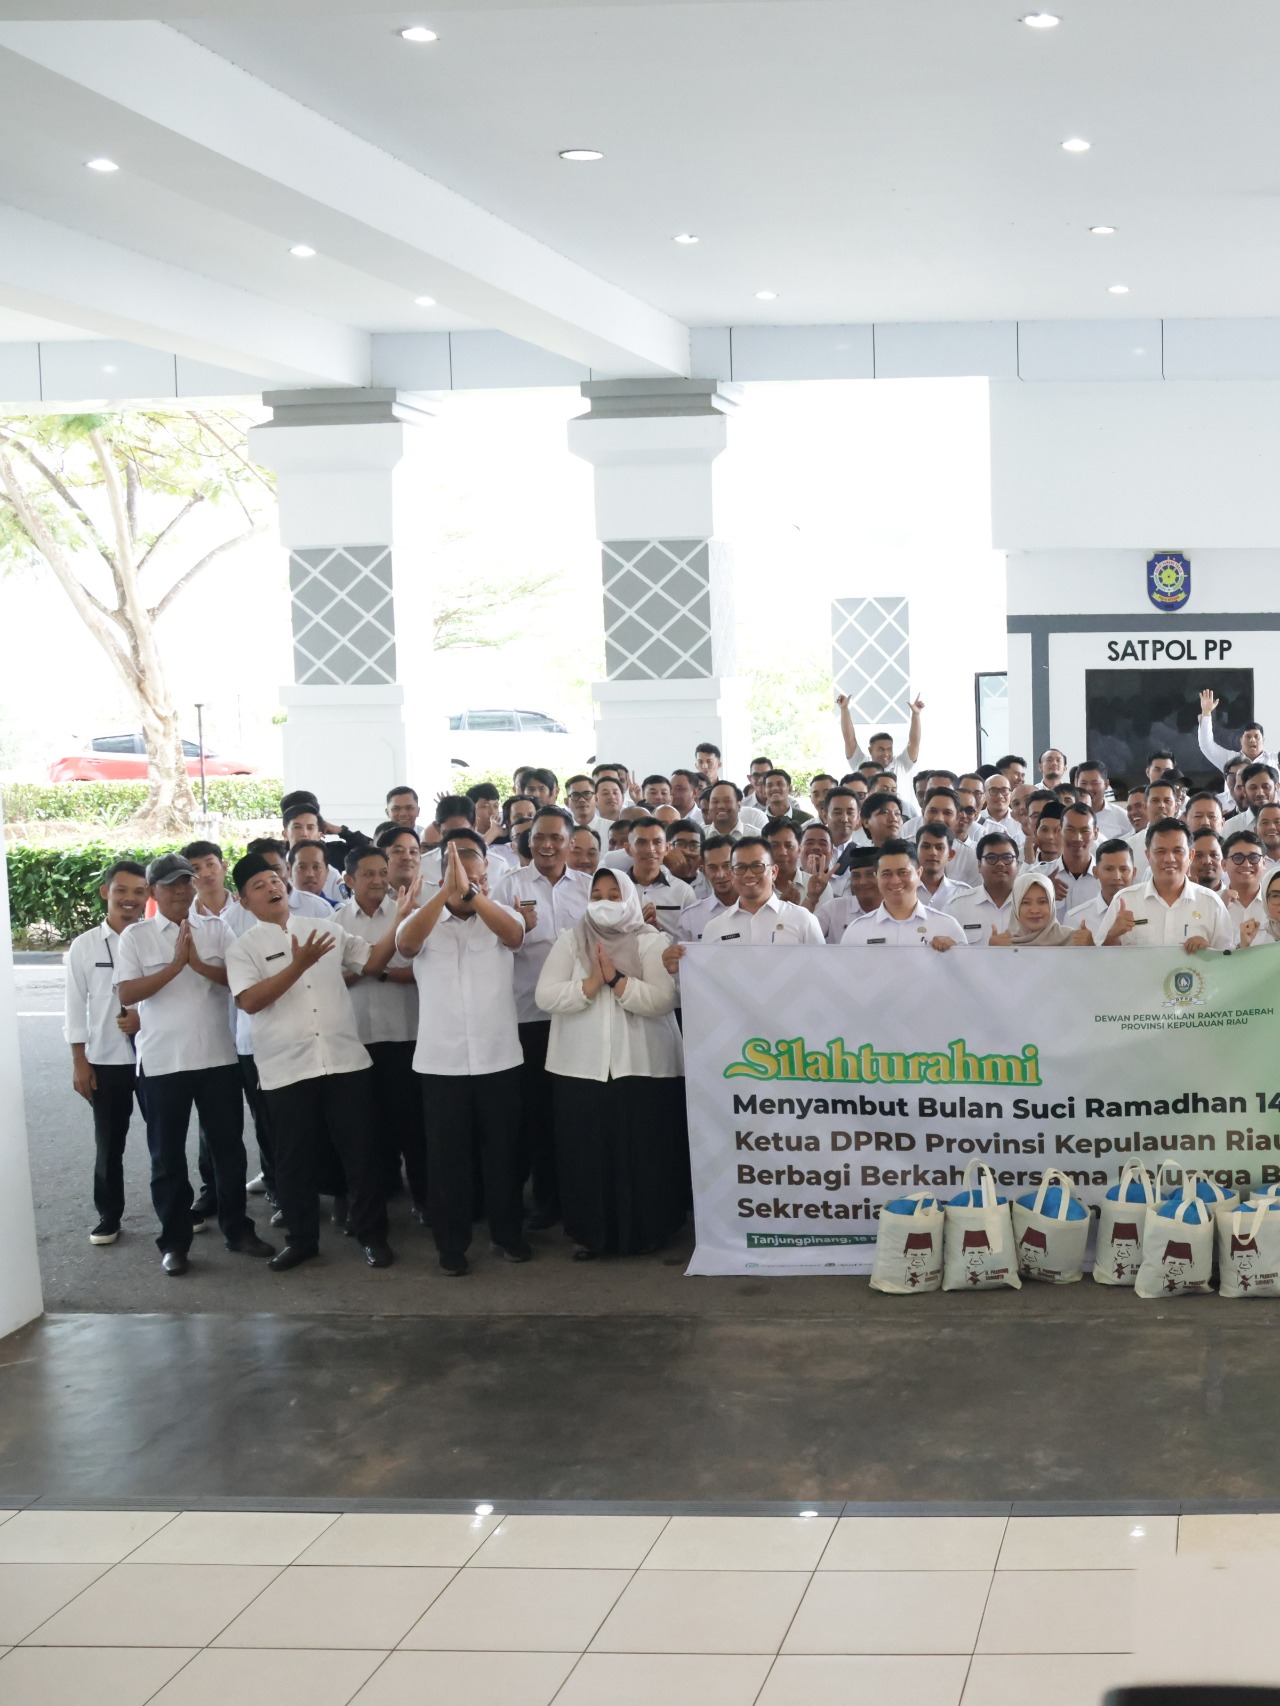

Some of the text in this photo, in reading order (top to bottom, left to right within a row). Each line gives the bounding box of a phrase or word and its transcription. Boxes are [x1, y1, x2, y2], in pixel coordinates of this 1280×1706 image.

[1107, 639, 1232, 661] SATPOL PP
[1094, 1008, 1274, 1023] DEWAN PERWAKILAN RAKYAT DAERAH
[1121, 1017, 1248, 1031] PROVINSI KEPULAUAN RIAU
[723, 1036, 1043, 1087] Silahturahmi
[733, 1093, 909, 1120] Menyambut
[918, 1096, 1003, 1118] Bulan
[1012, 1096, 1075, 1119] Suci
[1085, 1092, 1247, 1118] Ramadhan
[735, 1130, 820, 1152] Ketua
[831, 1131, 916, 1152] DPRD
[925, 1132, 1045, 1154] Provinsi
[1055, 1132, 1215, 1158] Kepulauan
[737, 1163, 850, 1191] Berbagi
[860, 1164, 964, 1186] Berkah
[738, 1198, 883, 1220] Sekretaria
